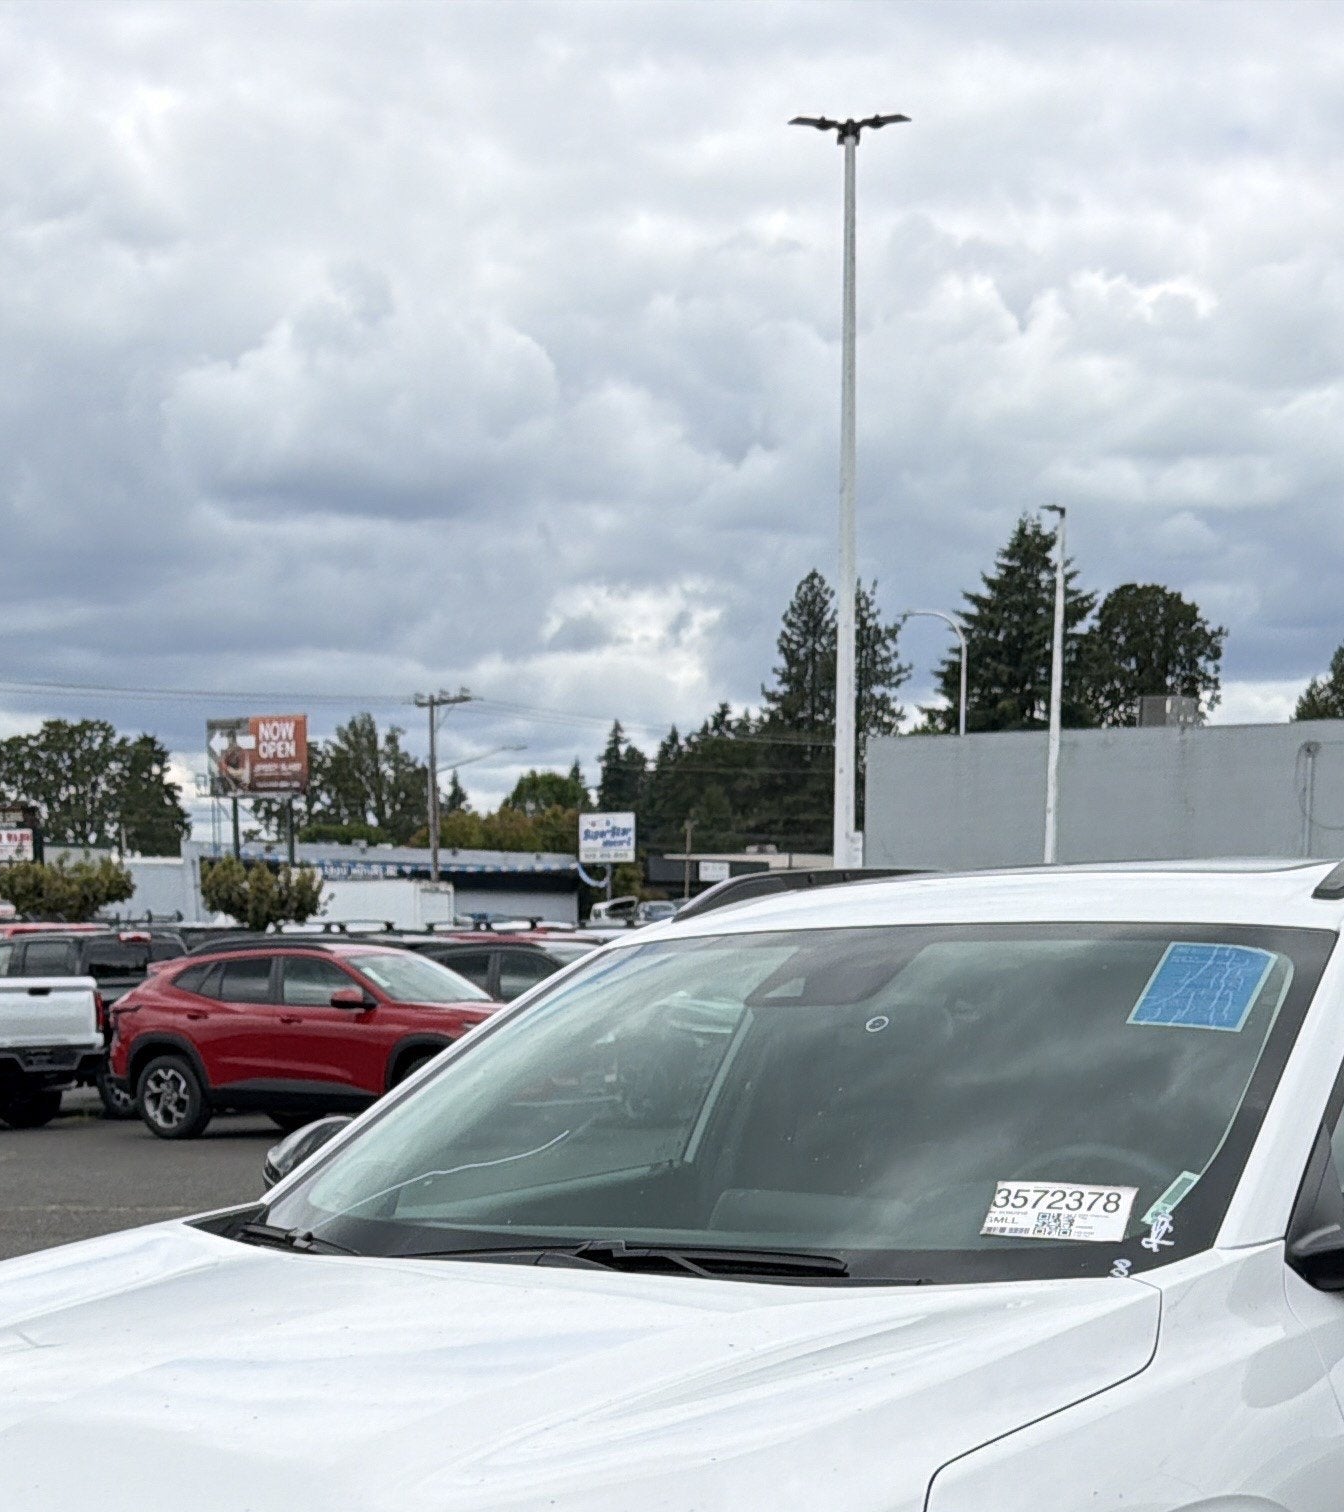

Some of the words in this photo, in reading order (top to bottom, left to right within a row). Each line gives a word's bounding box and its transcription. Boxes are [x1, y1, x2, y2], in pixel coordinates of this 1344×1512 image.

[258, 721, 295, 741] NOW
[258, 740, 296, 759] OPEN
[992, 1188, 1123, 1214] 3572378
